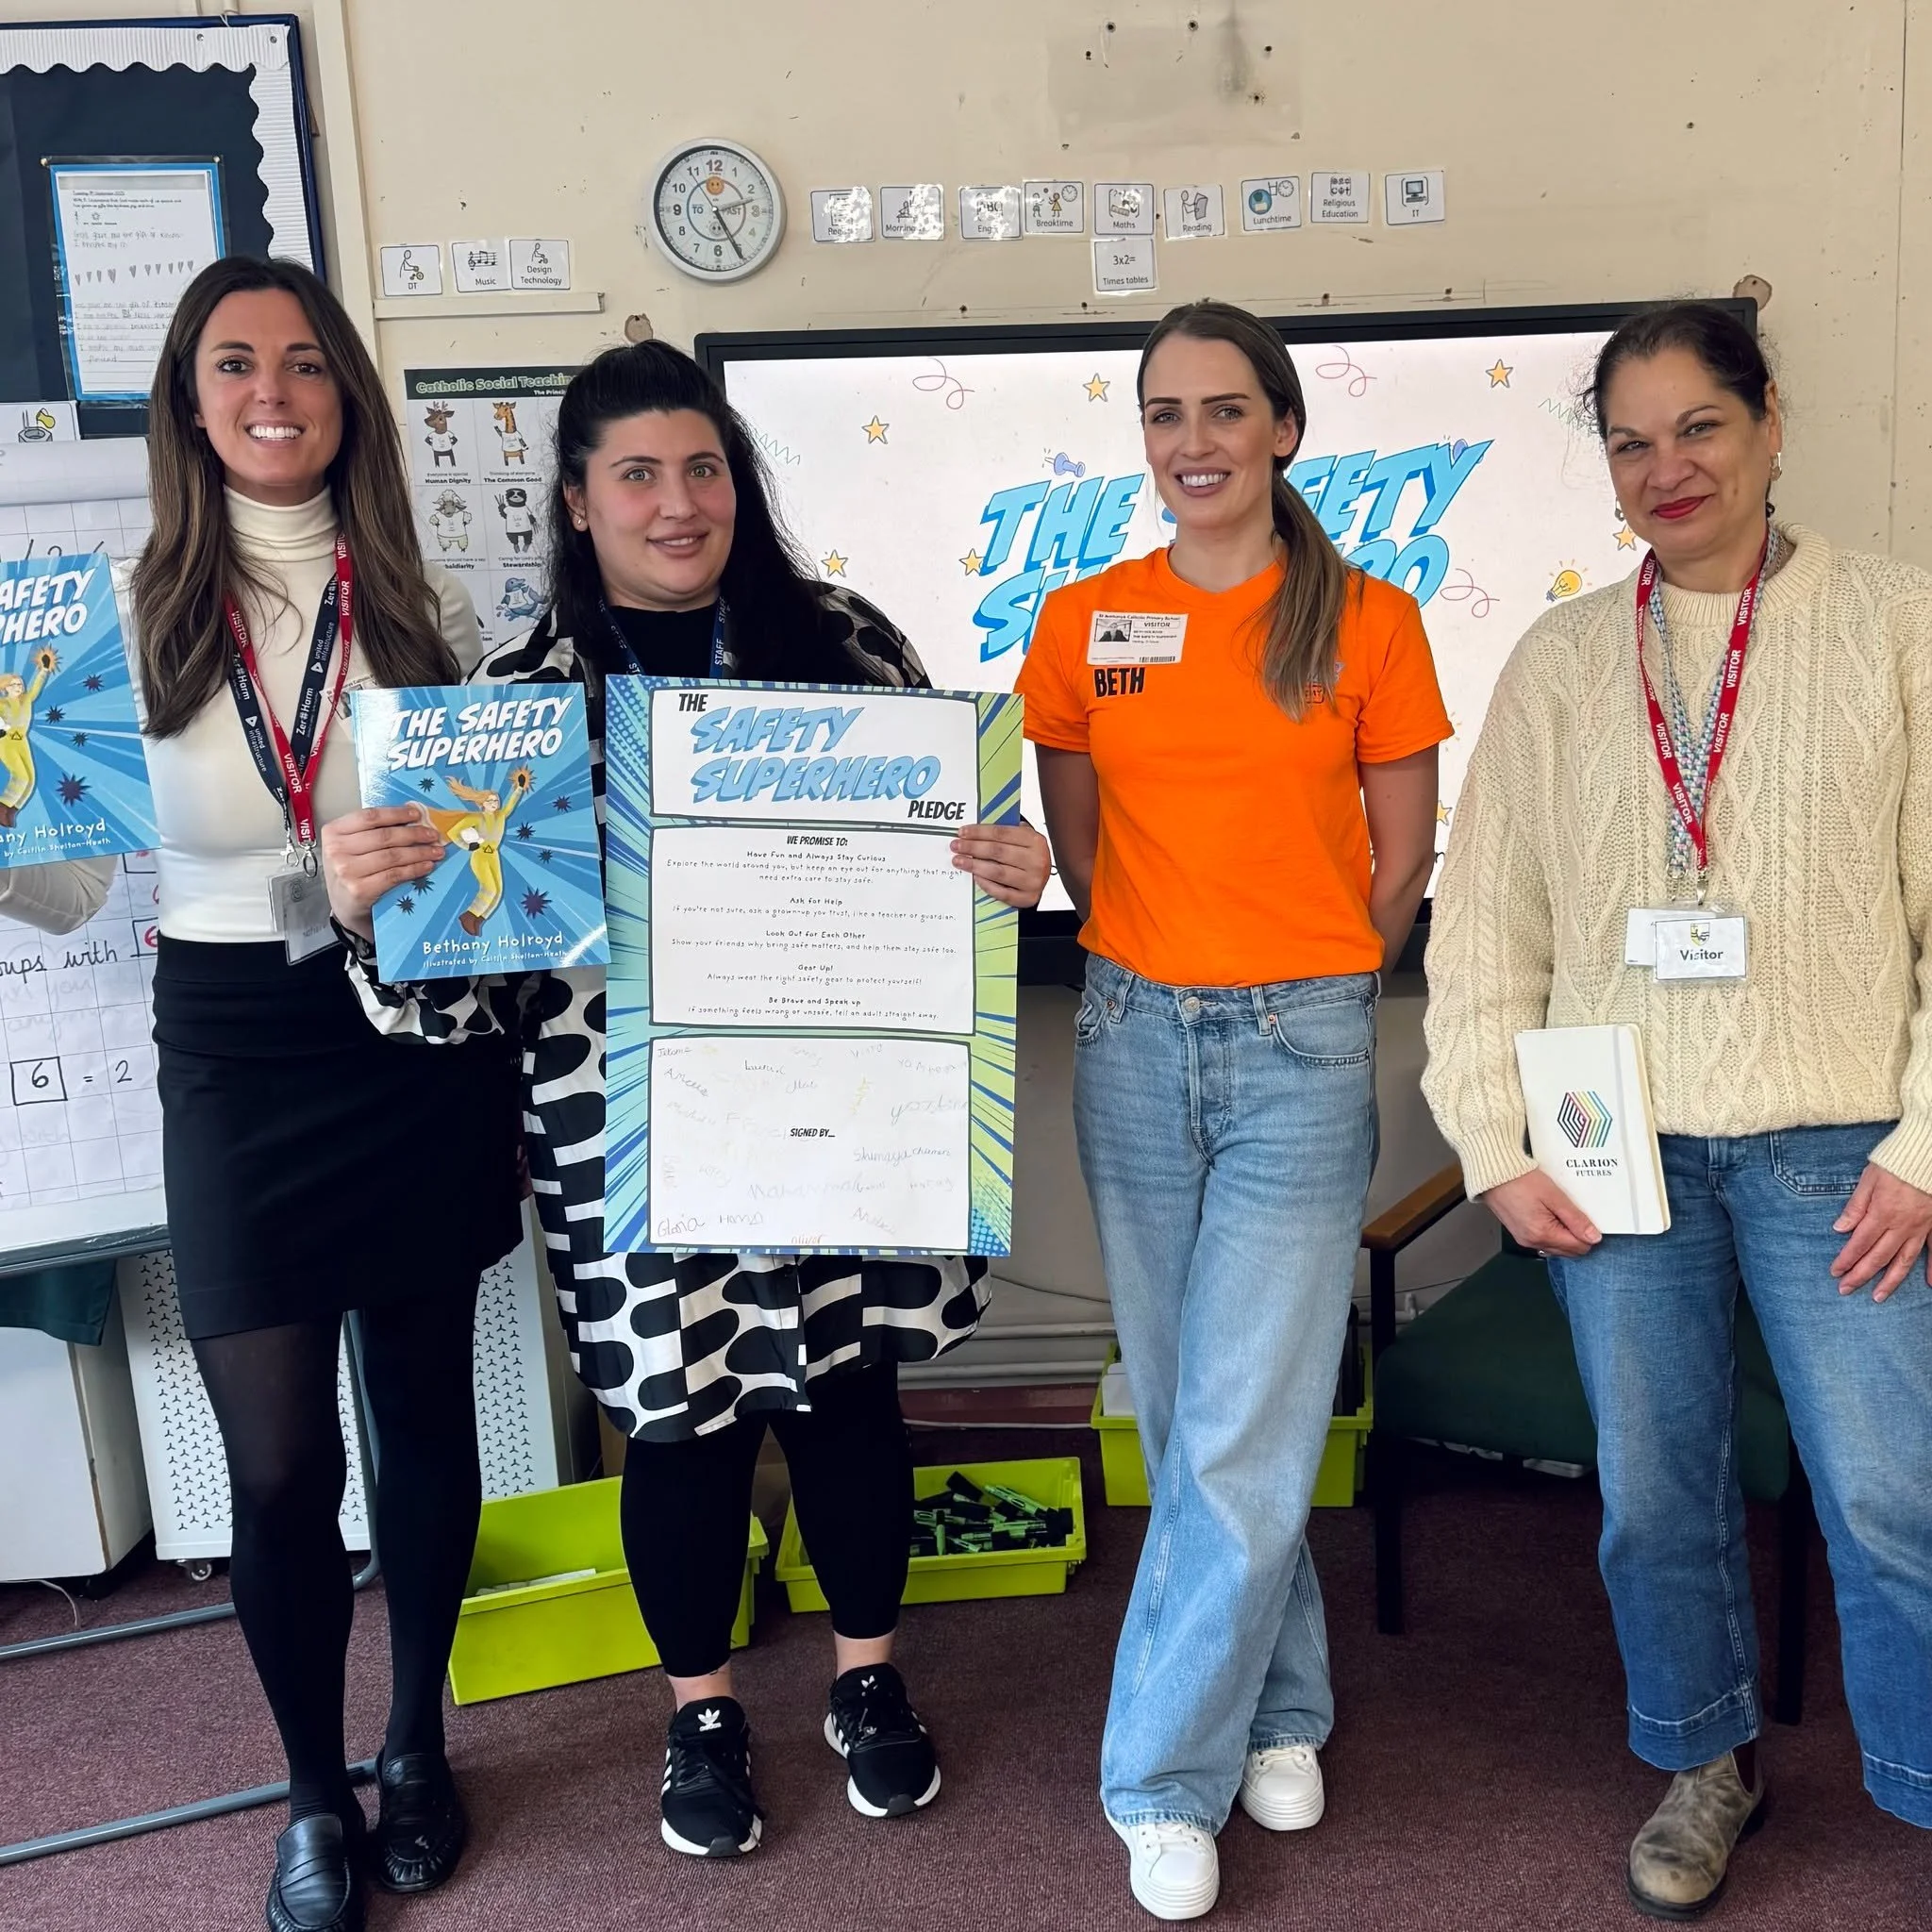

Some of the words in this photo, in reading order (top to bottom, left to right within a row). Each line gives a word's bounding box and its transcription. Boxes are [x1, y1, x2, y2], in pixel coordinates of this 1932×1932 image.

[687, 166, 700, 176] 11
[706, 159, 723, 172] 12
[731, 167, 738, 177] 1
[672, 183, 686, 193] 10
[747, 184, 755, 194] 2
[673, 204, 682, 216] 9
[692, 206, 704, 214] TO
[1324, 199, 1356, 208] Religious
[1036, 219, 1074, 227] Breaktime
[1113, 221, 1136, 229] Maths
[1183, 223, 1212, 234] Reading
[1253, 214, 1292, 225] Lunchtime
[678, 226, 686, 236] 8
[693, 243, 700, 253] 7
[713, 244, 723, 257] 6
[526, 266, 553, 275] Design
[521, 275, 562, 286] Technology
[1126, 275, 1149, 285] tables
[416, 378, 475, 394] Catholic
[475, 376, 519, 391] Social
[979, 473, 1145, 578] THE
[0, 567, 97, 612] AFETY
[341, 580, 350, 616] VISITOR
[1737, 586, 1753, 627] VISITOR
[0, 602, 88, 648] HERO
[231, 609, 249, 649] VISITOR
[314, 639, 325, 659] united
[340, 640, 351, 676] VISITOR
[715, 638, 724, 666] STAFF
[1725, 649, 1742, 690] VISITOR
[1094, 667, 1145, 698] BETH
[678, 693, 708, 712] THE
[388, 706, 448, 740] THE
[457, 695, 575, 737] SAFETY
[254, 728, 266, 749] united
[691, 706, 866, 754] SAFETY
[1713, 711, 1730, 755] VISITOR
[248, 729, 267, 772] infrastructure
[387, 727, 563, 772] SUPERHERO
[1655, 723, 1673, 760] VISITOR
[283, 753, 303, 794] VISITOR
[691, 755, 941, 804] SUPERHERO
[908, 800, 966, 821] PLEDGE
[1672, 781, 1693, 824] VISITOR
[34, 817, 106, 840] Holroyd
[787, 836, 798, 845] WE
[800, 836, 834, 846] PROMISE
[836, 837, 848, 847] TO:
[806, 853, 834, 861] Always
[838, 854, 854, 862] Stay
[666, 859, 698, 868] Explore
[887, 867, 920, 877] anything
[941, 870, 962, 879] might
[834, 875, 851, 885] stay
[423, 938, 491, 955] Bethany
[498, 930, 564, 951] Holroyd
[64, 940, 117, 970] with
[468, 957, 478, 965] by
[481, 955, 508, 963] Caitlin
[1680, 949, 1724, 961] Visitor
[820, 965, 834, 974] Up!
[708, 974, 735, 983] Always
[775, 975, 795, 985] right
[824, 977, 843, 986] gear
[32, 1061, 48, 1089] 6
[115, 1059, 132, 1083] 2
[790, 1128, 818, 1138] SIGNED
[1566, 1158, 1619, 1169] CLARION
[1575, 1169, 1612, 1177] FUTURES
